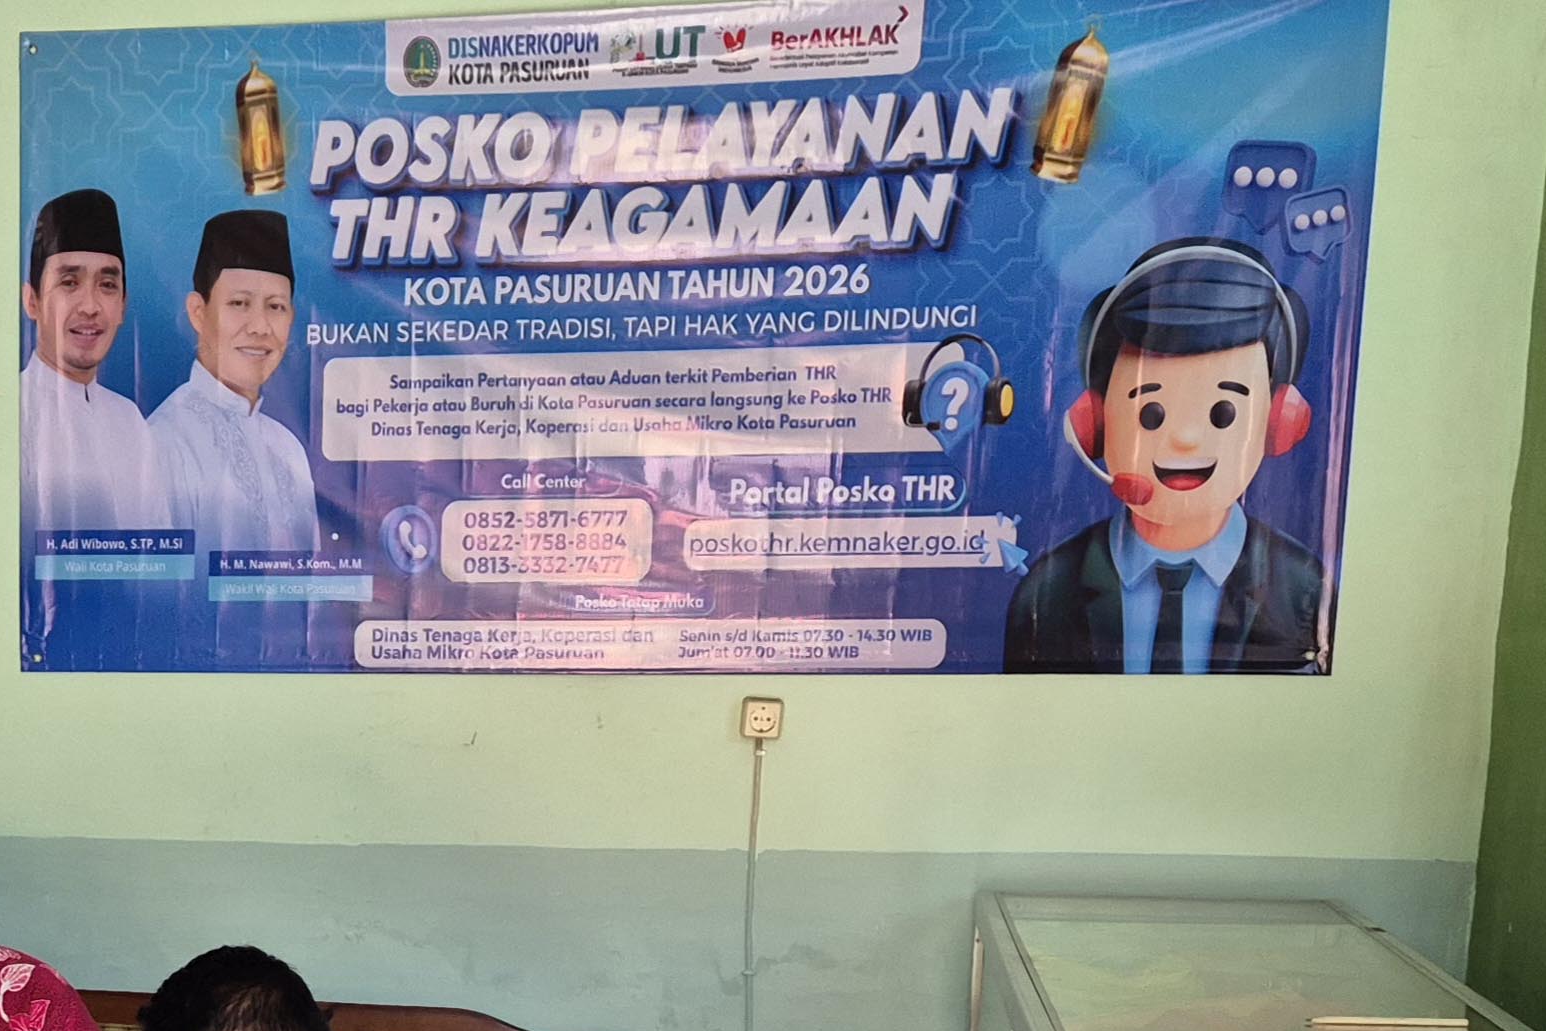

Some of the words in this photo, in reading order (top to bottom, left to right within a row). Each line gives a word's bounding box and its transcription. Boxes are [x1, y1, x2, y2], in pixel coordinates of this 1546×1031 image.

[448, 32, 599, 59] DISNAKERKOPUM
[771, 24, 900, 50] BerAKHLAK
[448, 63, 494, 86] KOTA
[499, 58, 590, 84] PASURUAN
[310, 111, 554, 187] POSKO
[569, 87, 1016, 178] PELAYANAN
[330, 194, 456, 261] THR
[474, 173, 956, 258] KEAGAMAAN
[403, 276, 488, 306] KOTA
[494, 271, 661, 305] PASURUAN
[667, 266, 775, 300] TAHUN
[783, 263, 871, 298] 2026
[306, 322, 389, 345] BUKAN
[395, 319, 509, 343] SEKEDAR
[516, 316, 616, 341] TRADISI,
[623, 315, 676, 337] TAPI
[684, 313, 738, 336] HAK
[745, 311, 816, 335] YANG
[823, 304, 977, 333] DILINDUNGI
[389, 373, 474, 393] Sampaikan
[477, 372, 566, 392] Pertanyaan
[570, 371, 605, 386] atau
[608, 370, 661, 386] Aduan
[665, 368, 708, 384] terkit
[711, 366, 797, 384] Pemberian
[805, 365, 837, 381] THR
[336, 398, 369, 417] bagi
[373, 397, 428, 417] Pekerja
[432, 398, 467, 413] atau
[470, 395, 516, 412] Buruh
[520, 395, 534, 411] di
[537, 395, 574, 411] Kota
[578, 394, 652, 411] Pasuruan
[654, 394, 705, 409] secara
[710, 391, 783, 410] langsung
[787, 389, 806, 406] ke
[810, 387, 858, 405] Posko
[860, 387, 892, 403] THR
[371, 421, 412, 437] Dinas
[417, 421, 471, 439] Tenaga
[475, 420, 521, 439] Kerja,
[525, 418, 594, 438] Koperasi
[599, 417, 629, 434] dan
[633, 416, 682, 433] Usaha
[686, 415, 733, 432] Mikro
[737, 414, 775, 431] Kota
[779, 413, 857, 430] Pasuruan
[501, 473, 530, 490] Call
[533, 473, 587, 489] Center
[729, 476, 810, 504] Portal
[816, 474, 896, 503] Posko
[901, 474, 957, 502] THR
[463, 510, 628, 529] 0852-5871-6777
[46, 538, 58, 550] H.
[61, 538, 79, 549] Adi
[81, 538, 128, 551] Wibowo,
[159, 538, 183, 549] M.Si
[690, 529, 985, 556] poskothr.kemnaker.go.id
[64, 561, 87, 572] Wali
[89, 561, 114, 572] Kota
[116, 561, 166, 573] Pasuruan
[220, 559, 231, 569] H.
[234, 559, 247, 569] M.
[249, 558, 294, 570] Nawawi,
[339, 558, 362, 569] M.M
[280, 583, 304, 594] Kota
[574, 593, 617, 609] Posko
[662, 592, 705, 609] Muka
[372, 628, 418, 643] Dinas
[422, 628, 483, 646] Tenaga
[487, 628, 536, 646] Kerja,
[541, 628, 616, 646] Koperasi
[622, 627, 654, 643] dan
[679, 630, 721, 643] Senin
[725, 628, 748, 643] s/d
[752, 629, 798, 643] Kamis
[804, 629, 844, 642] 07.30
[857, 628, 896, 642] 14.30
[900, 629, 933, 642] WIB
[372, 645, 422, 660] Usaha
[427, 645, 475, 660] Mikro
[480, 645, 519, 660] Kota
[524, 646, 605, 660] Pasuruan
[678, 645, 729, 659] Jum'at
[827, 646, 860, 658] WIB
